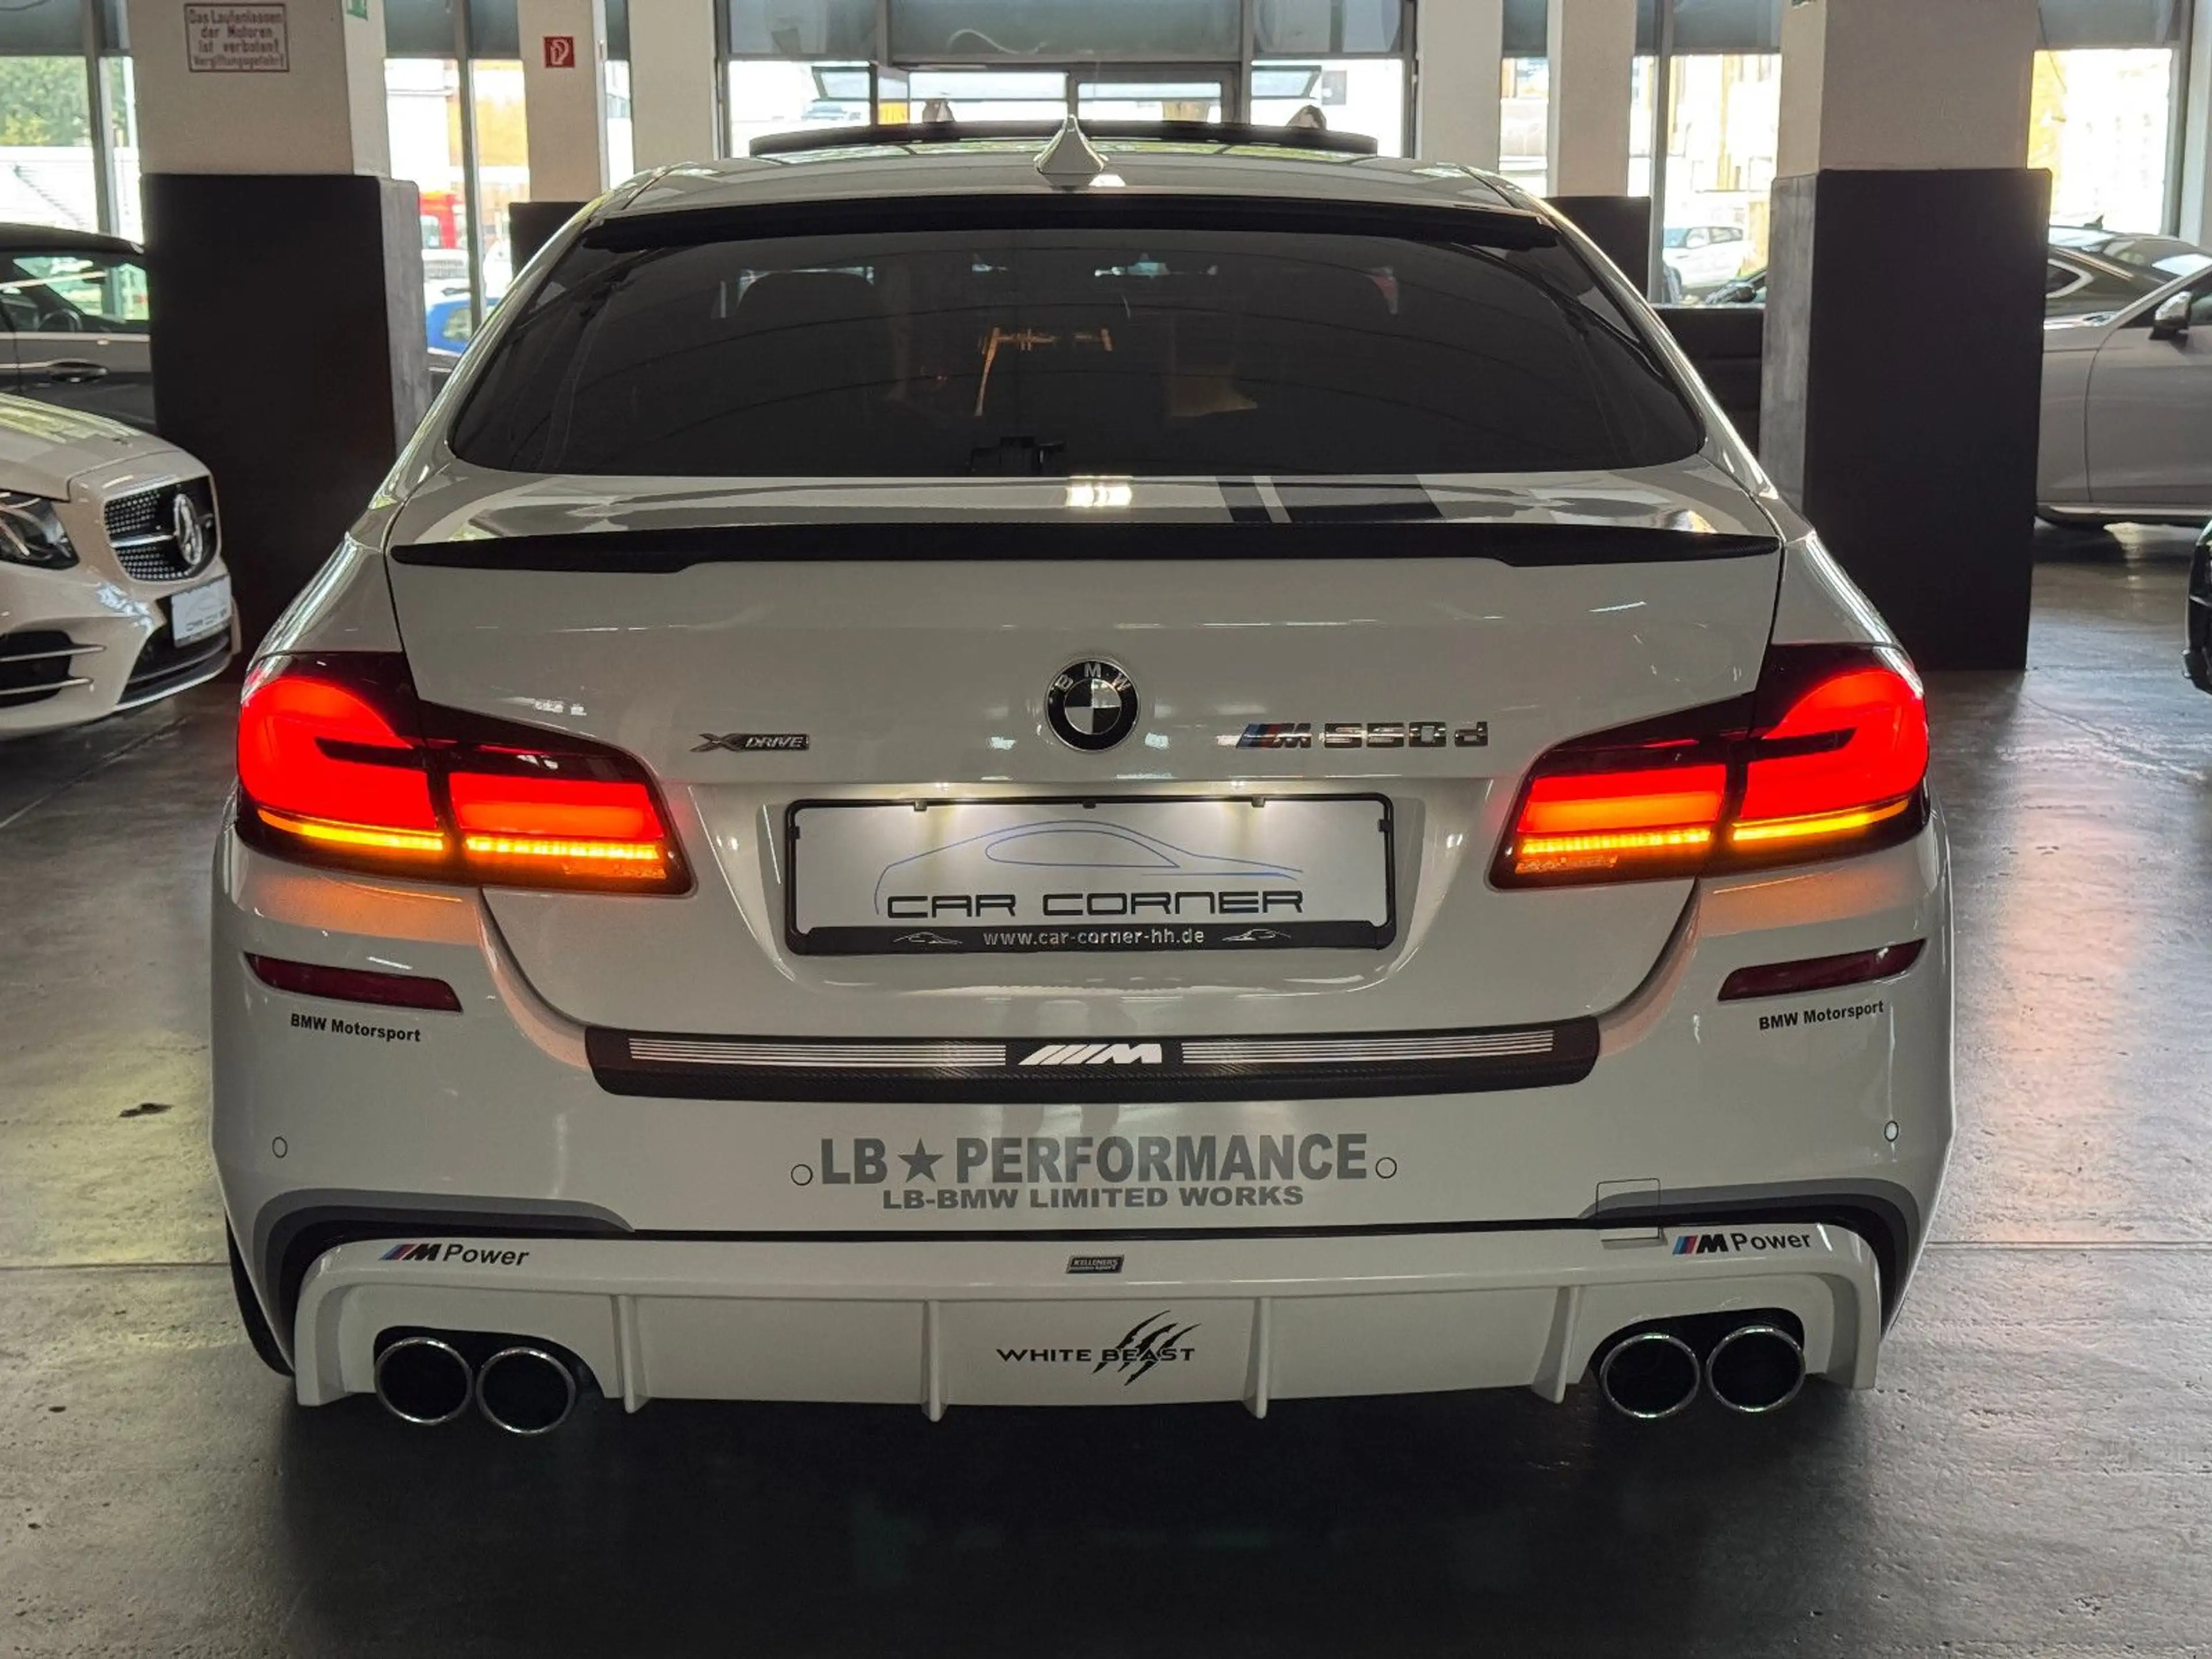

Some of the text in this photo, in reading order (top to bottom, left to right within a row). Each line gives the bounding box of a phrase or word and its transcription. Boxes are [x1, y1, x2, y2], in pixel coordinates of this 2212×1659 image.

[1055, 662, 1131, 692] BMW
[887, 889, 1304, 919] CAR CORNER
[983, 928, 1205, 947] www.car-corner-hh.de
[291, 1013, 421, 1042] BMW Motorsport
[1759, 1000, 1884, 1031] BMW Motorsport
[821, 1133, 1368, 1185] LB PERFORMANCE
[883, 1185, 1304, 1210] LB-BMW LIMITED WORKS
[442, 1243, 531, 1266] Power
[1730, 1232, 1811, 1252] Power
[996, 1347, 1195, 1362] WHITE BEAST
